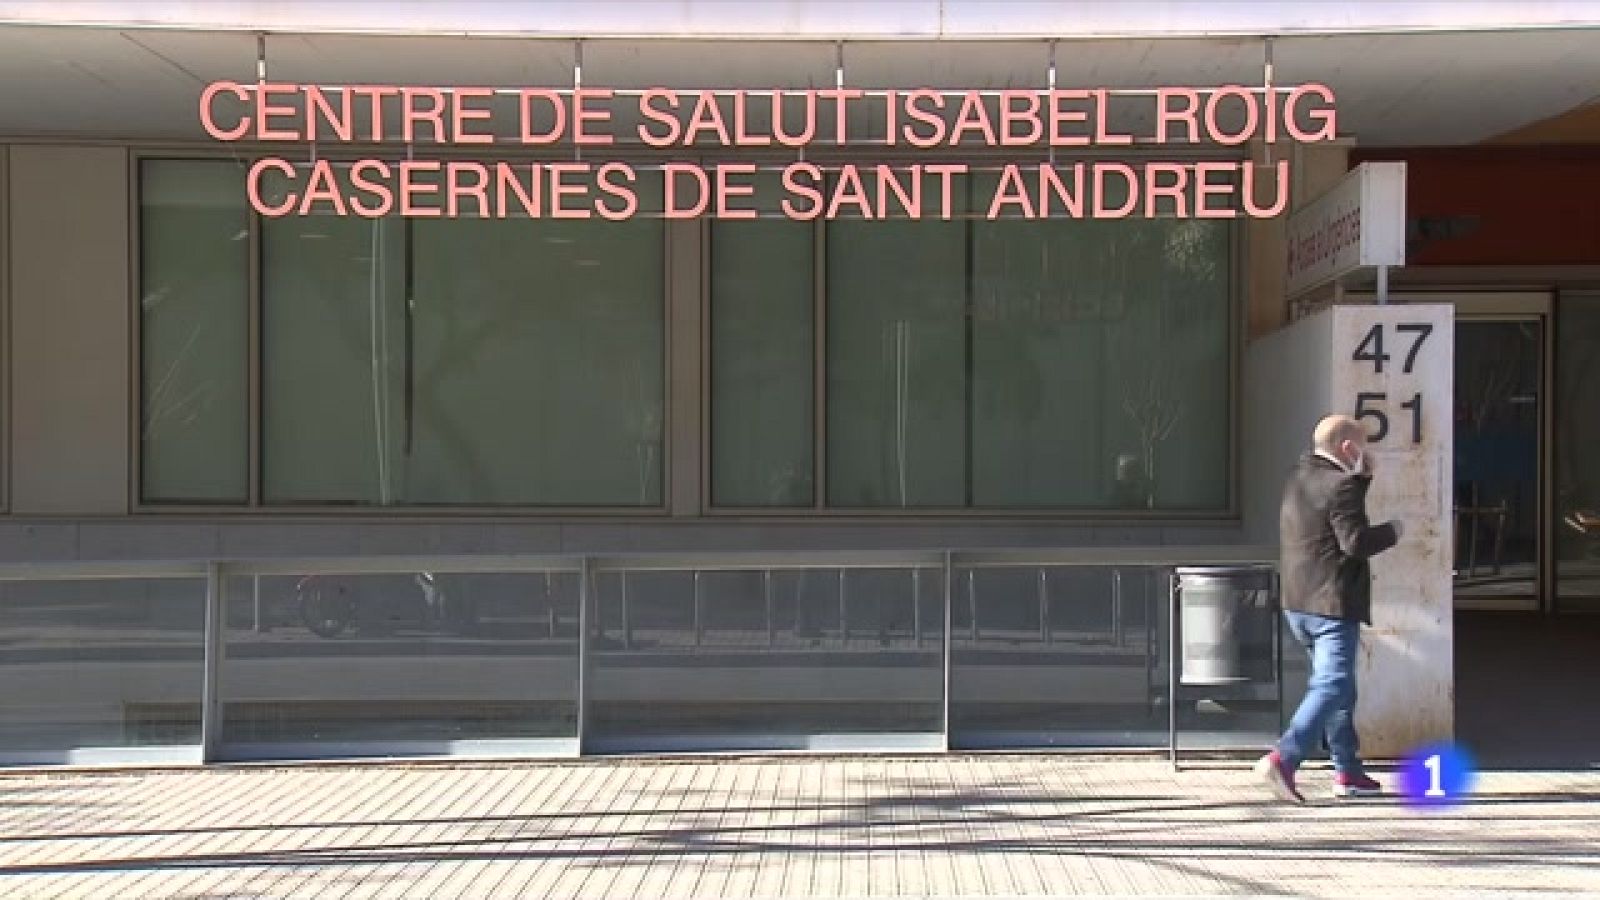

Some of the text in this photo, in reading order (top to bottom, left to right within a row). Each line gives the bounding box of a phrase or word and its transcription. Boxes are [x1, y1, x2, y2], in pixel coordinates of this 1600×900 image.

[199, 80, 1336, 146] CENTRE DE SALUT ISABEL ROIG
[247, 158, 1289, 220] CASERNES DE SANT ANDREU
[1352, 323, 1433, 374] 47
[1354, 392, 1423, 443] 51
